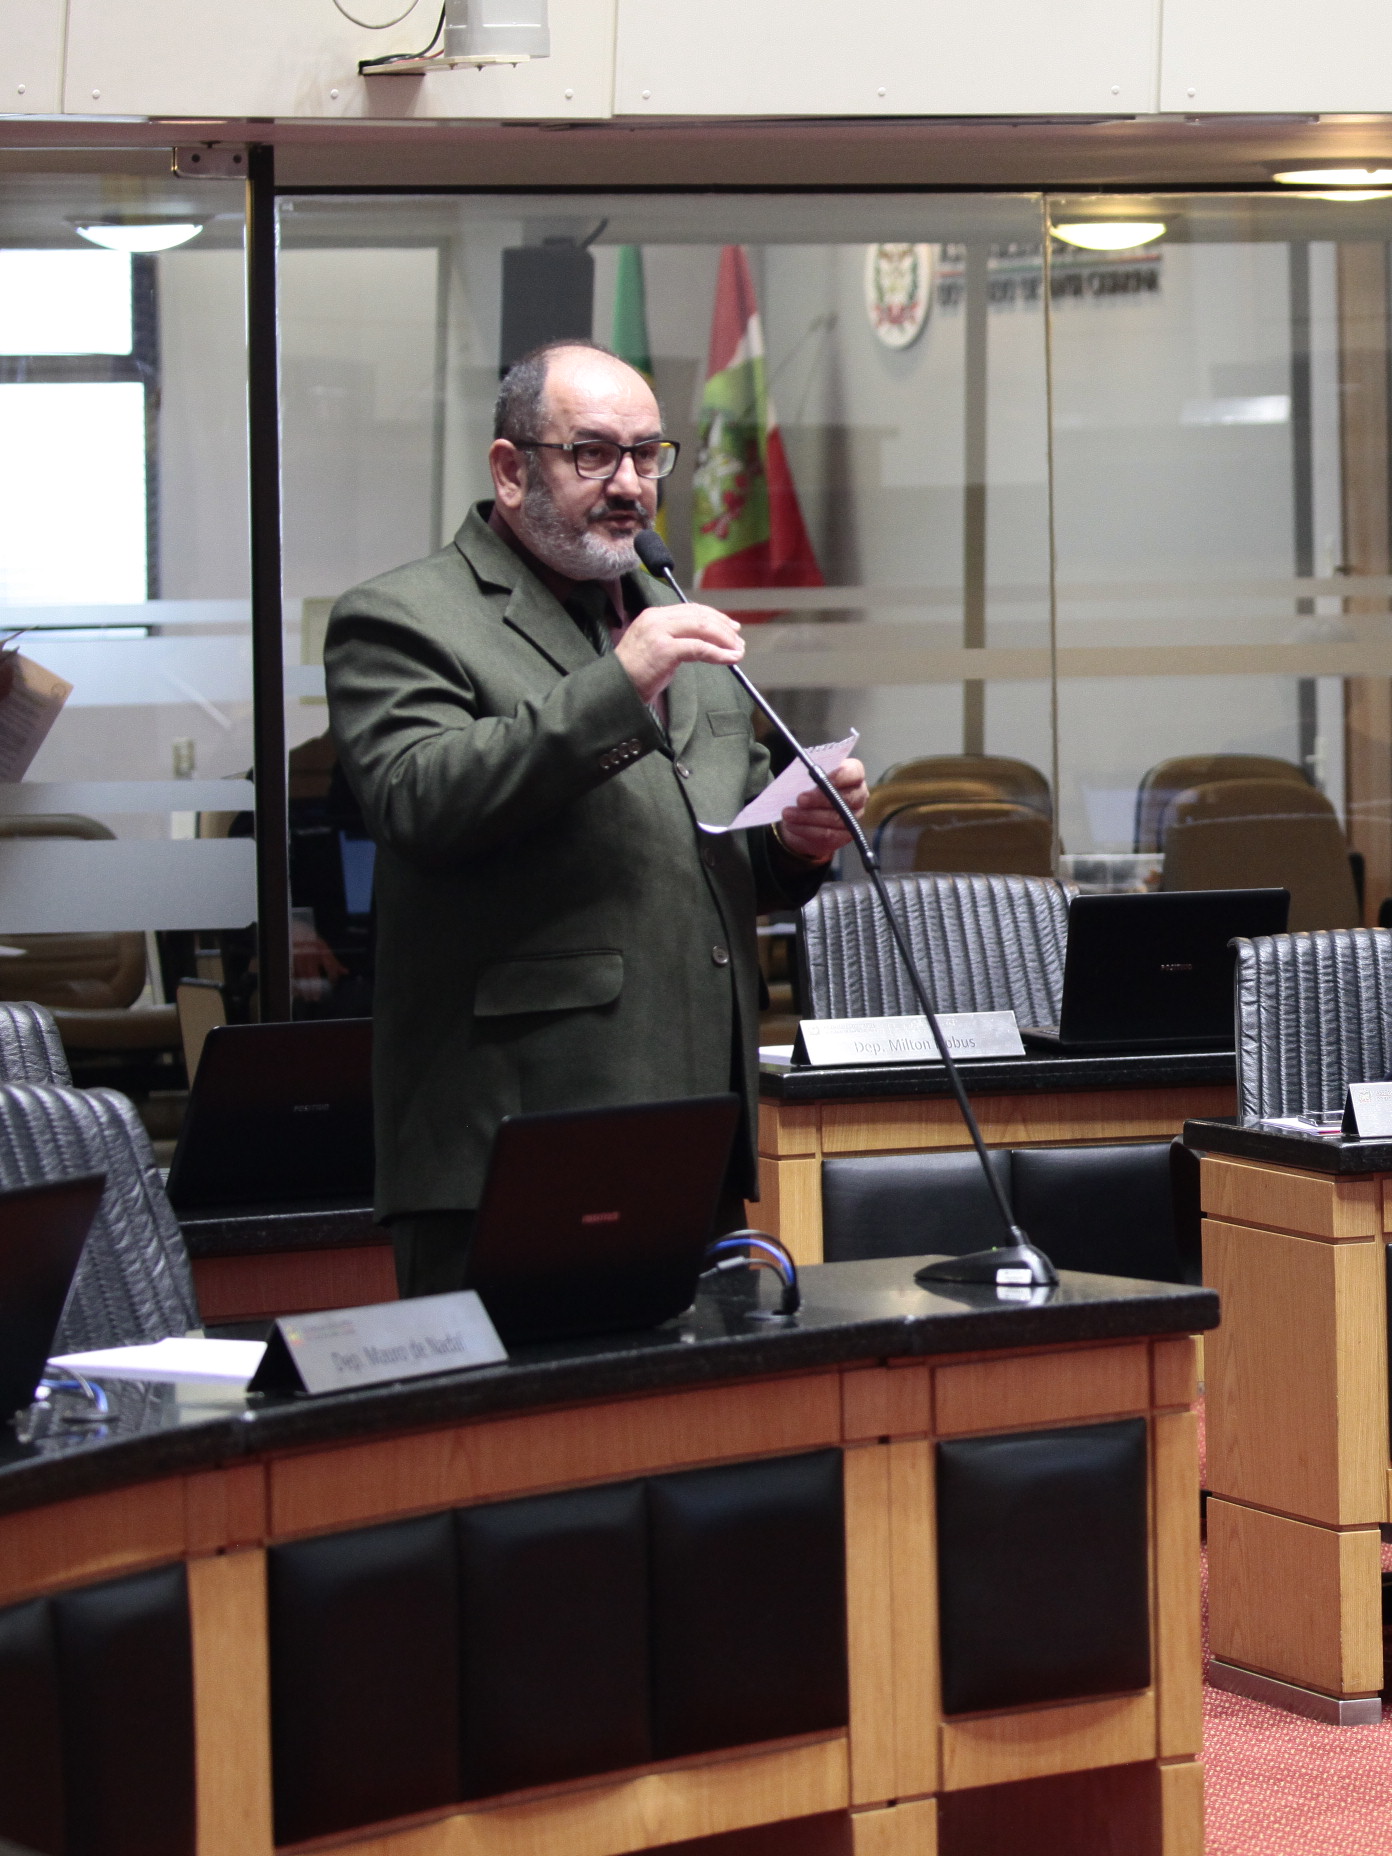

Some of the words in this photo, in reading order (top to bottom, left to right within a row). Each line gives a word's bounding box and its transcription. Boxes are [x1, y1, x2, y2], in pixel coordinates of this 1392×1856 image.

[854, 1040, 885, 1056] Dep.
[888, 1038, 932, 1052] Milton
[937, 1036, 976, 1050] obus
